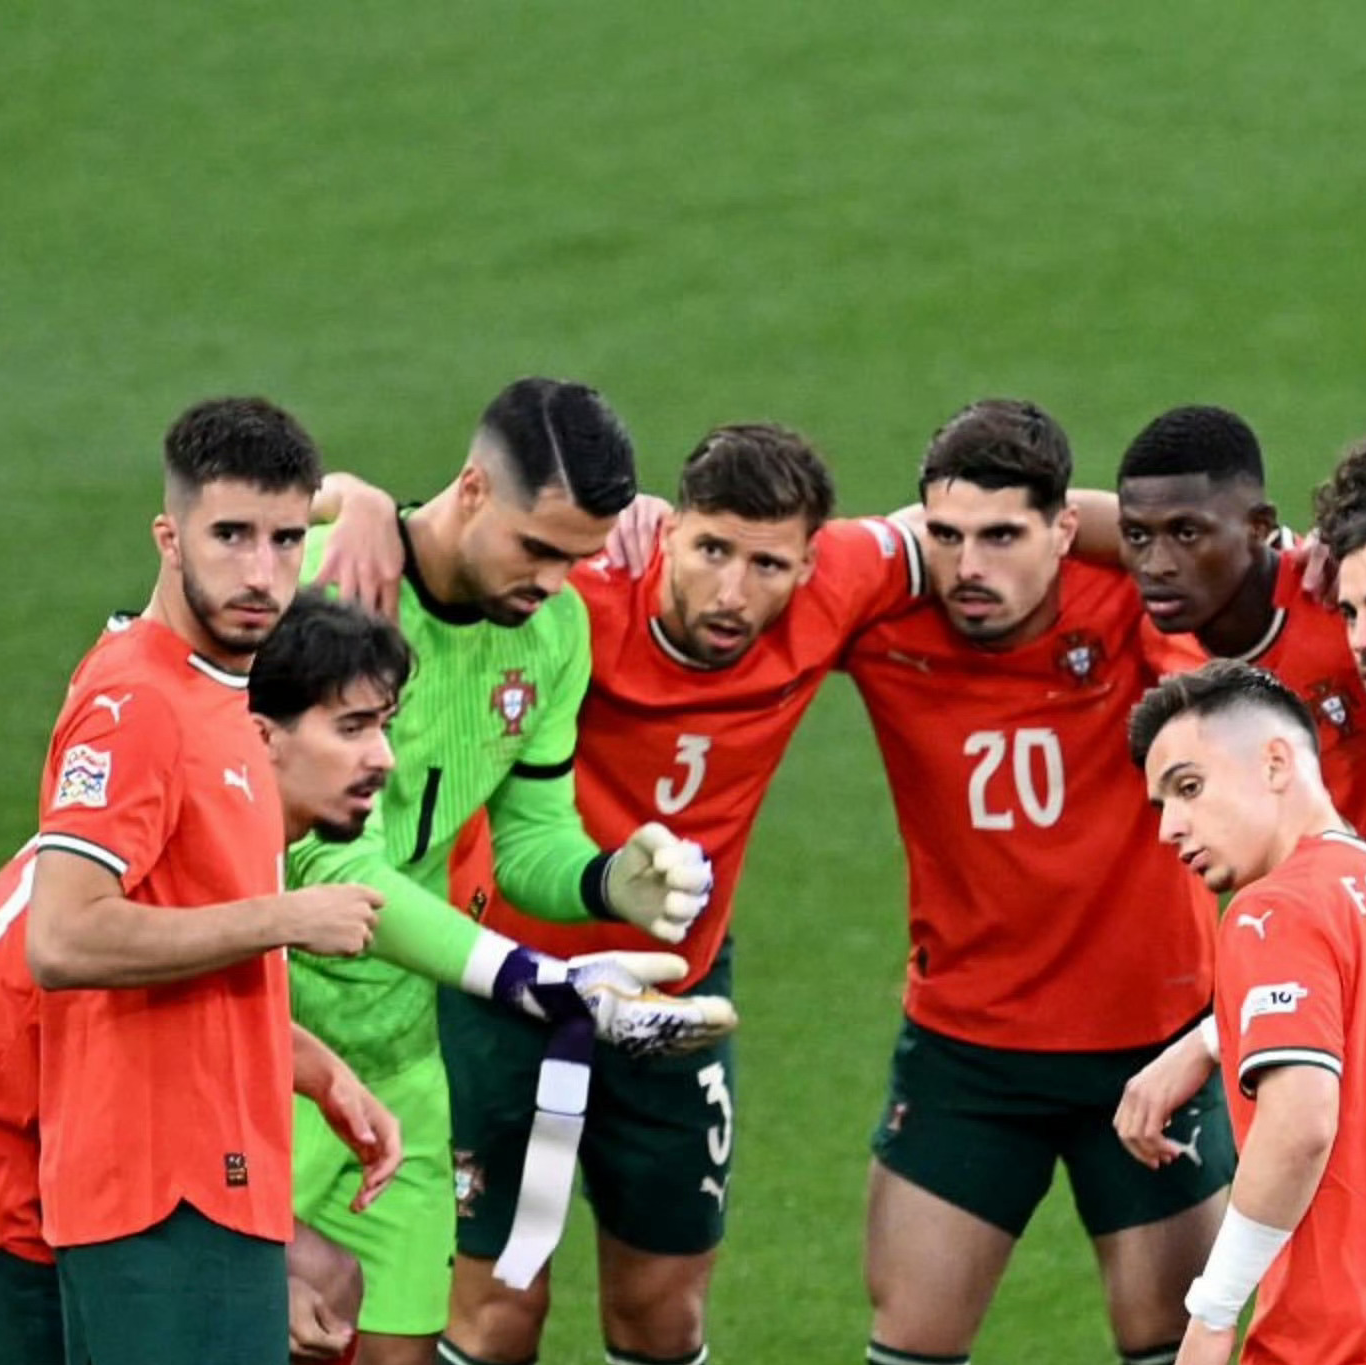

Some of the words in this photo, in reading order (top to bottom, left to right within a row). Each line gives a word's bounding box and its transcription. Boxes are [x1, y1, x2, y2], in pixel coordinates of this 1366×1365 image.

[655, 733, 712, 816] 3
[963, 728, 1065, 831] 20
[697, 1061, 732, 1166] 3
